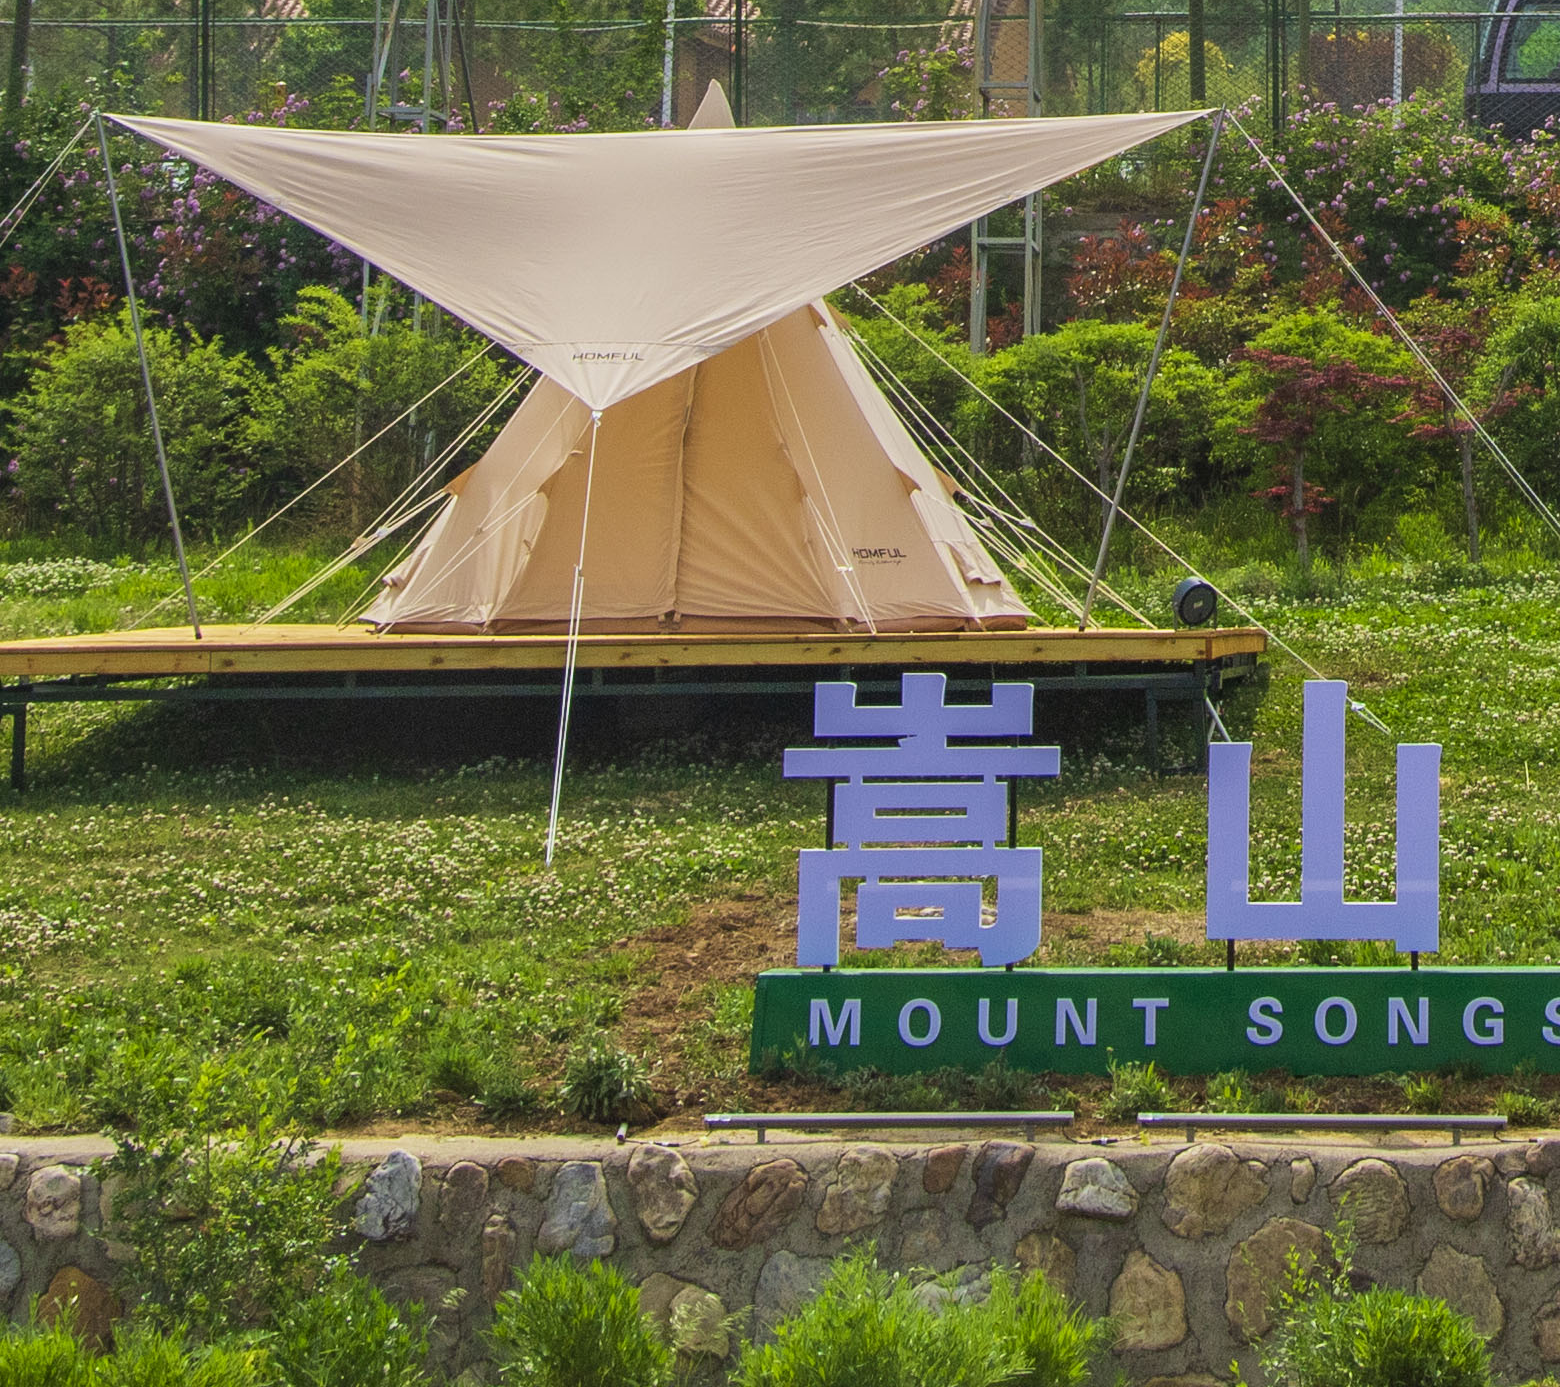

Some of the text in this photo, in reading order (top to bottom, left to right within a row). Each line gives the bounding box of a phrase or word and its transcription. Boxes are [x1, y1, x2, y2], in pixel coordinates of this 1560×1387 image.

[572, 352, 645, 361] HOMFUL
[851, 548, 907, 558] HOMFUL
[809, 996, 1170, 1047] MOUNT
